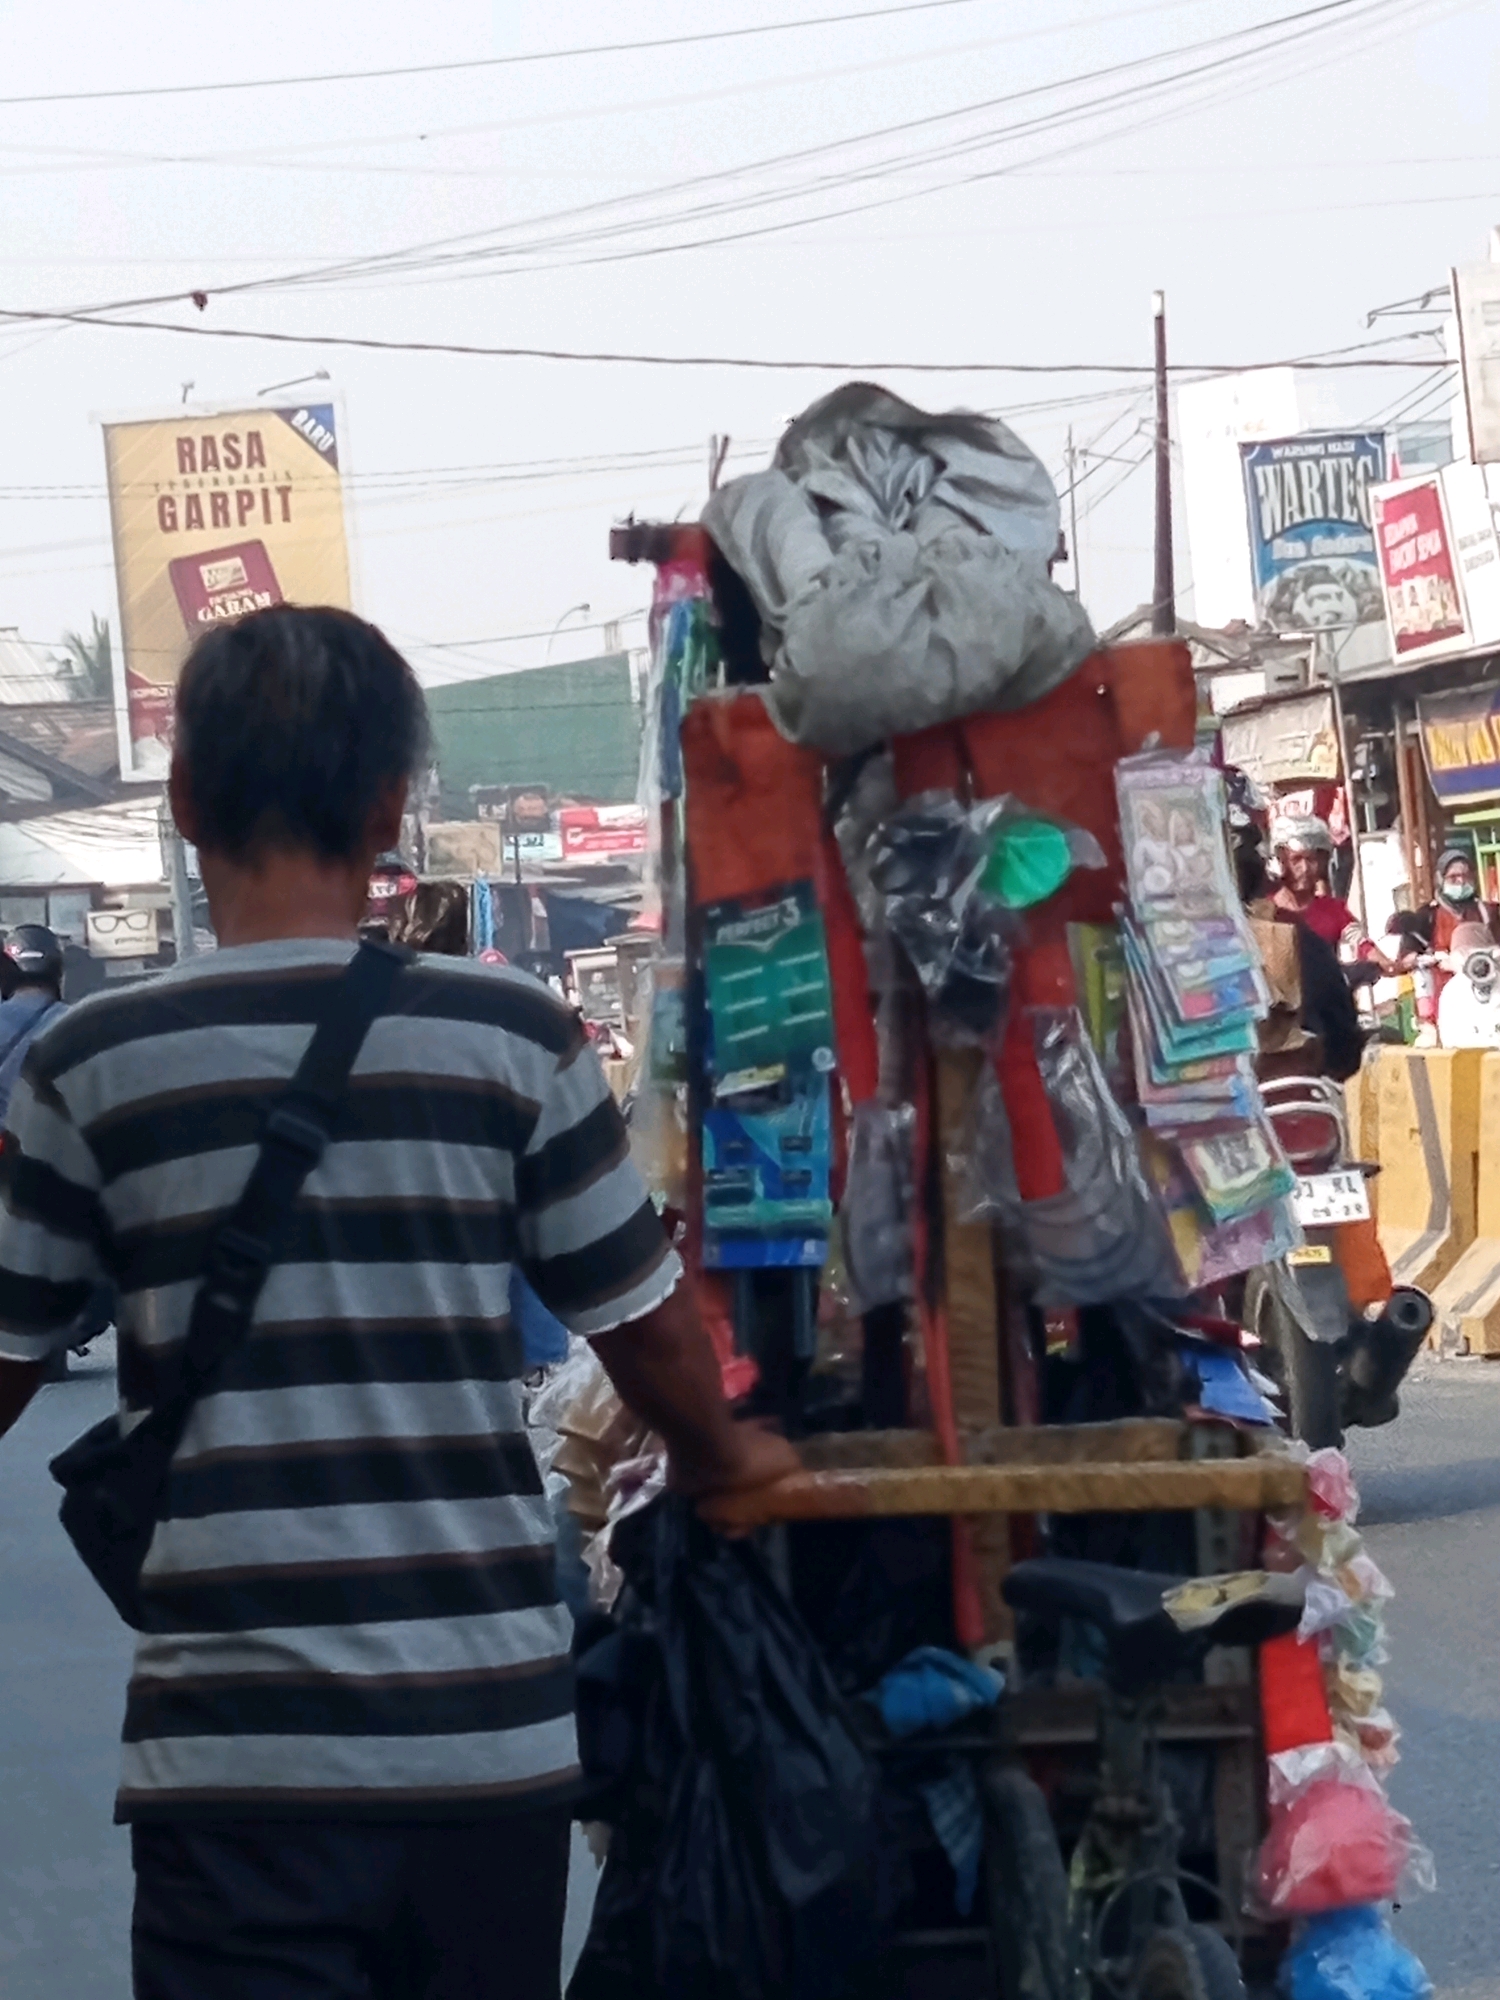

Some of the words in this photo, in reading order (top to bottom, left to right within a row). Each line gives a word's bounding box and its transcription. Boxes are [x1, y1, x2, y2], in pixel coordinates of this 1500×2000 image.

[176, 430, 267, 475] RASA
[290, 409, 336, 452] BARU
[156, 485, 293, 534] GARPIT
[197, 590, 271, 622] GARAM
